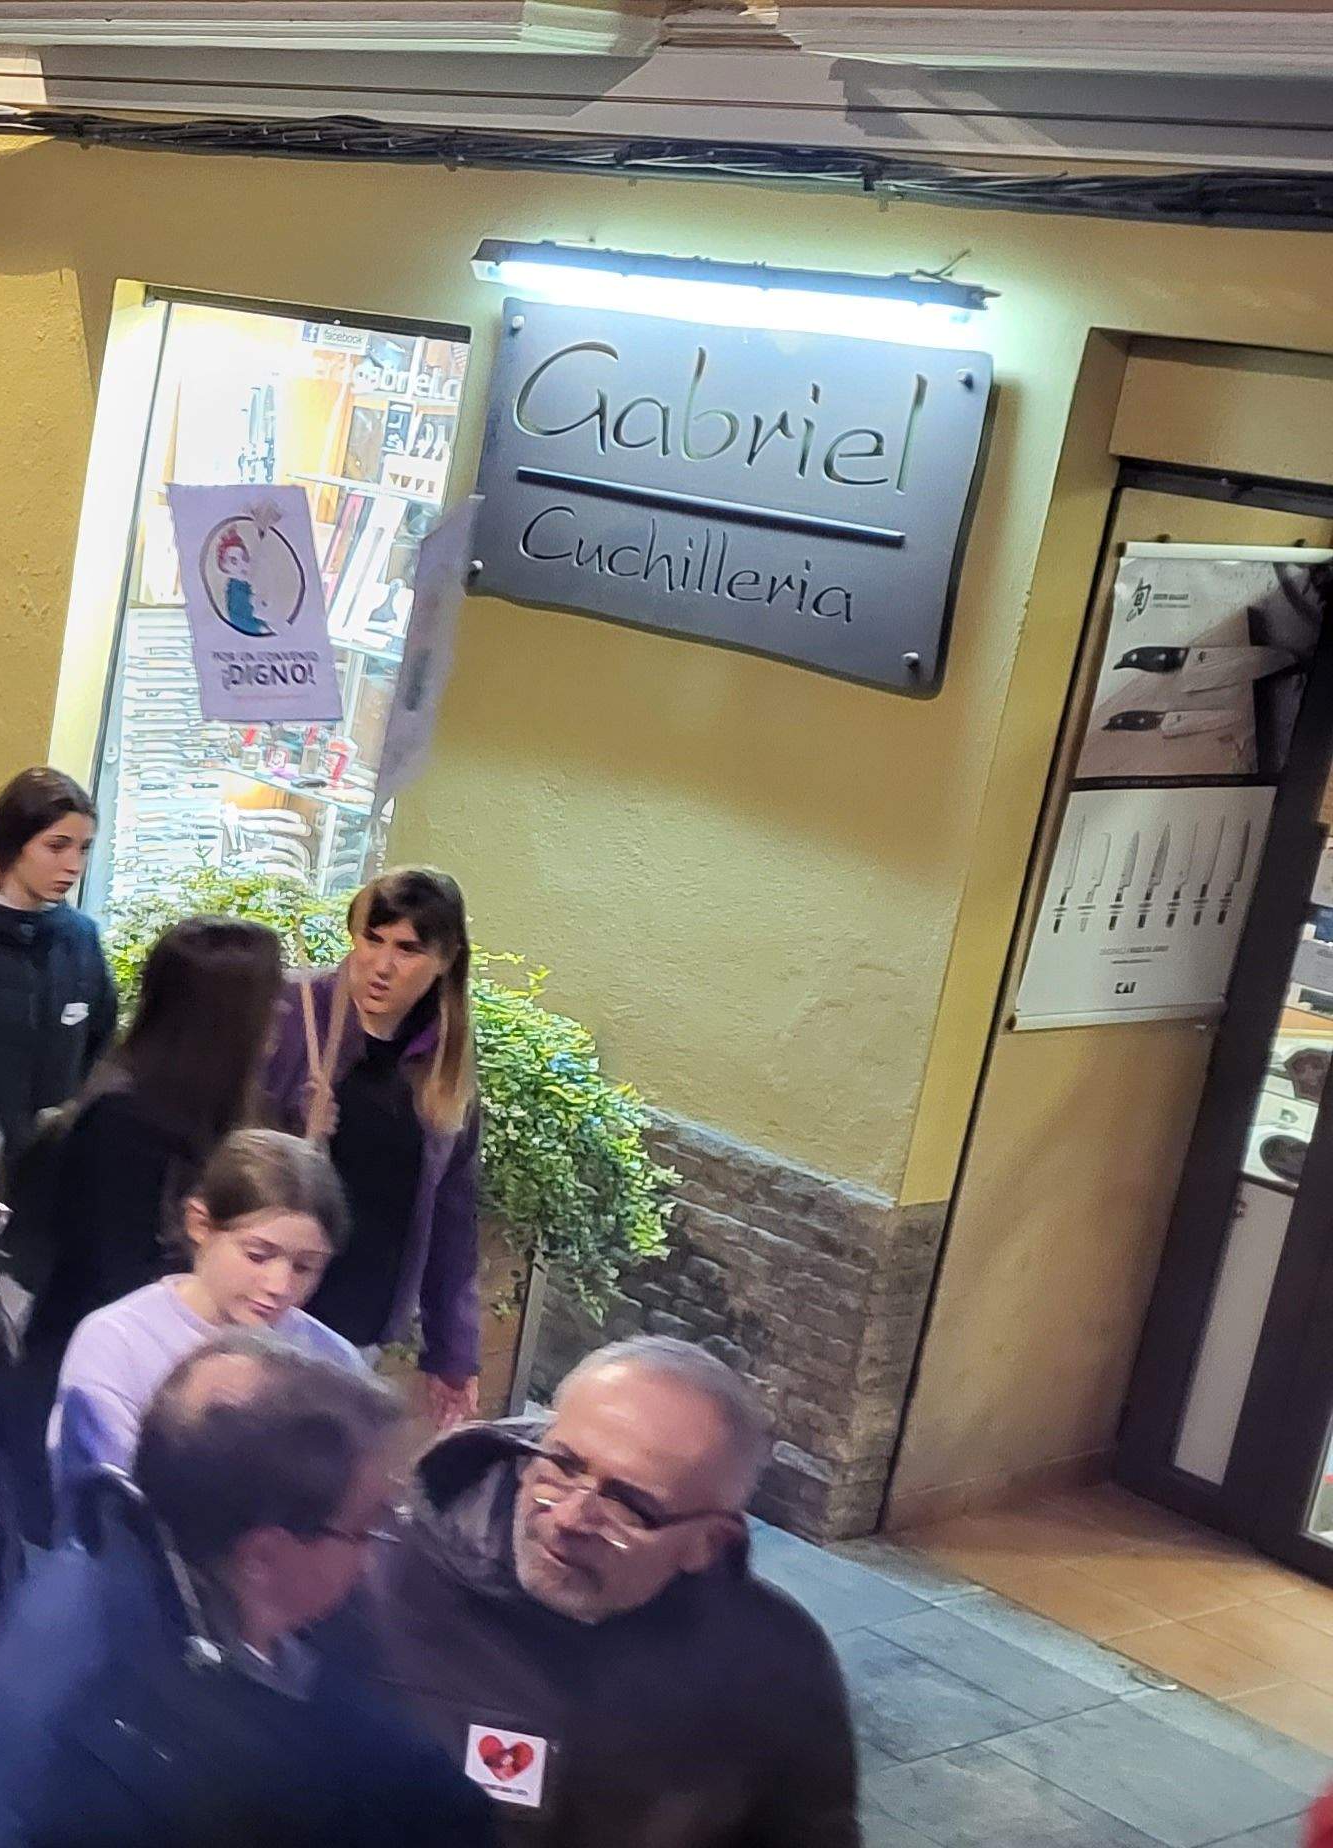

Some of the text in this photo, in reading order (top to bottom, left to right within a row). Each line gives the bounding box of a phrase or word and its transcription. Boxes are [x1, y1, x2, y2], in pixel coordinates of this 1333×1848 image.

[323, 328, 364, 344] facebook
[514, 340, 929, 492] Gabriel
[519, 505, 852, 624] Cuchilleria
[221, 663, 317, 691] ¡DIGNO!
